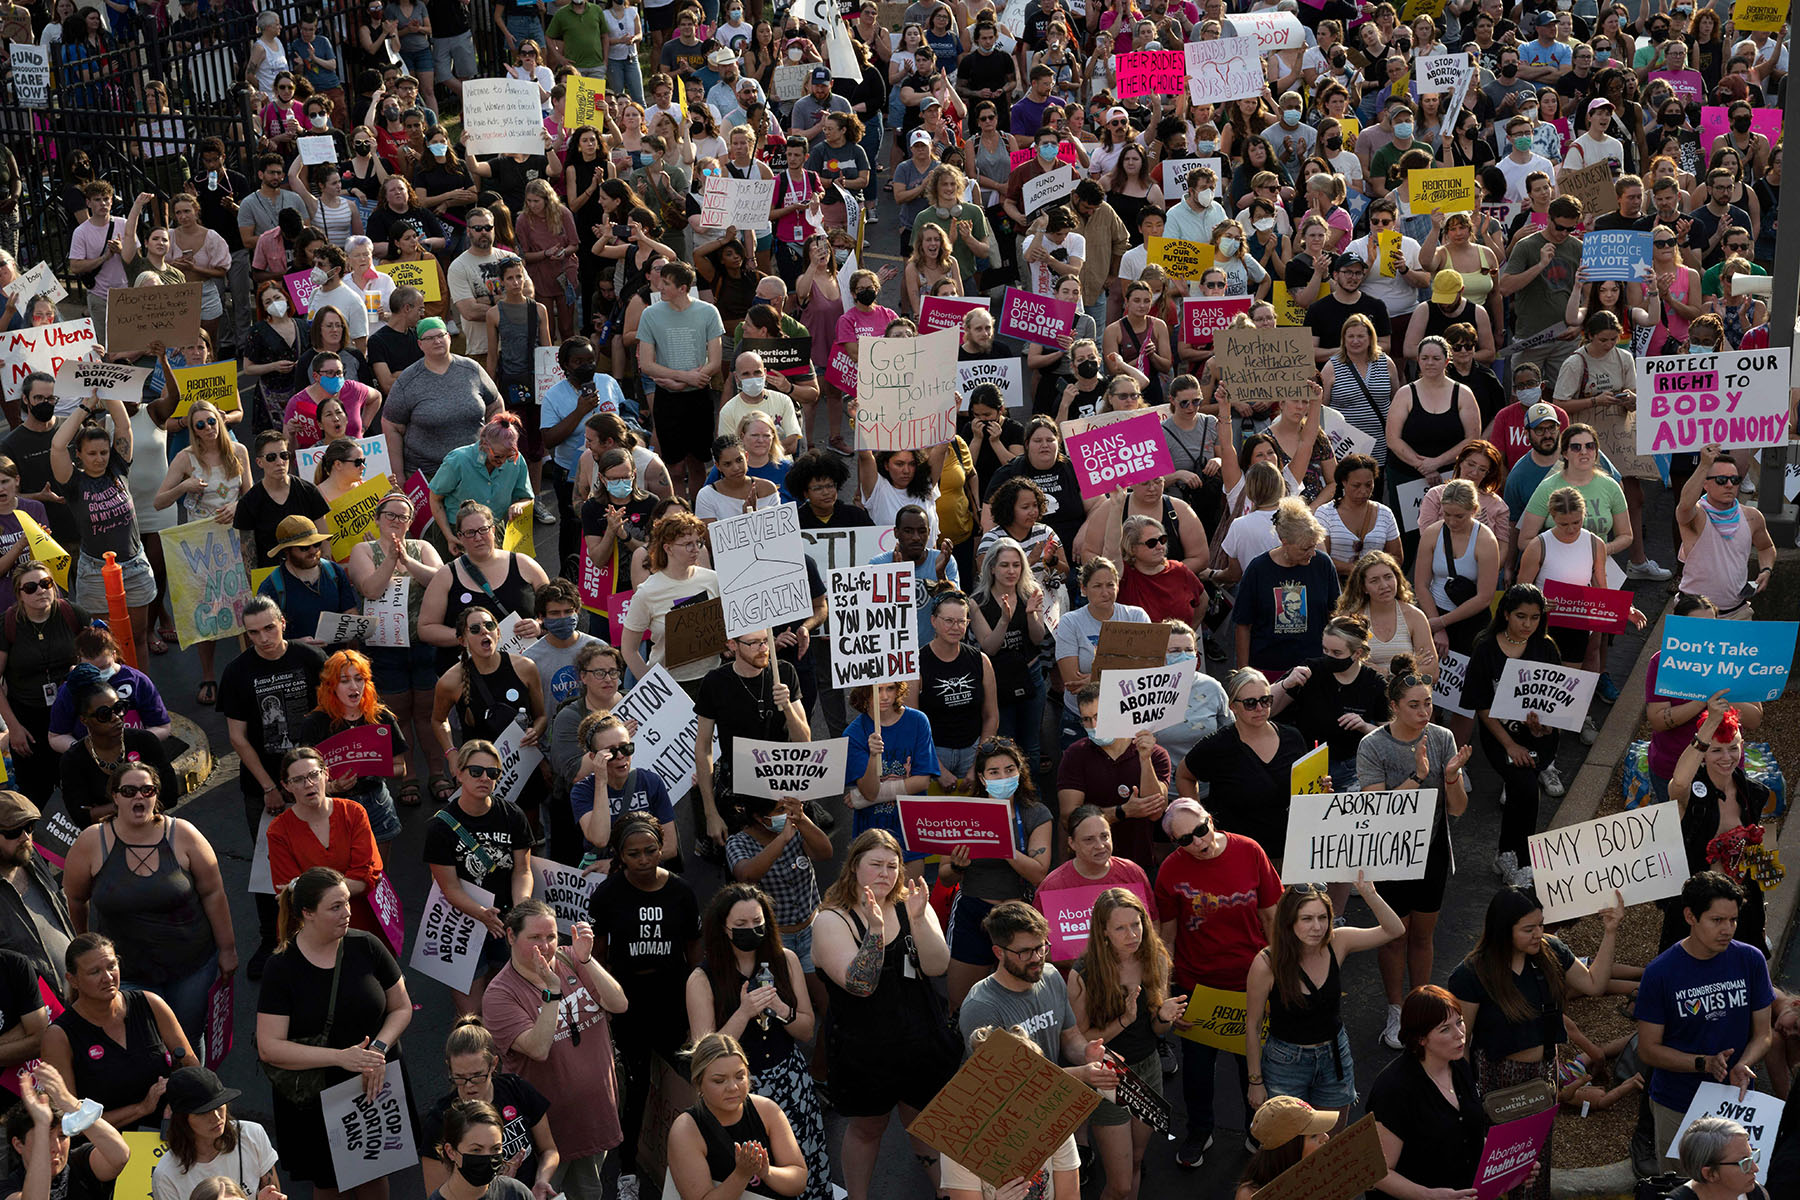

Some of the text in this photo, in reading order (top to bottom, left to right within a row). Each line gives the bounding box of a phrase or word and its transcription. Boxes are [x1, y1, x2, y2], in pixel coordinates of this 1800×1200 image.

[12, 52, 43, 65] FUND
[1190, 40, 1225, 65] HANDS
[1117, 52, 1184, 72] THEIR BODIES
[1434, 58, 1453, 68] STOP
[14, 73, 43, 86] CARE
[1426, 68, 1461, 80] ABORTION
[1435, 77, 1454, 86] BANS
[17, 86, 48, 98] NOW!
[1117, 74, 1183, 93] THEIR CHOICE
[706, 178, 733, 191] NOT
[1036, 176, 1056, 189] FUND
[1422, 178, 1462, 190] ABORTION
[704, 195, 730, 208] NOT
[1030, 182, 1065, 203] ABORTION
[701, 211, 728, 224] NOT
[1163, 241, 1200, 256] OUR BODIES
[1584, 233, 1632, 247] MY BODY
[1600, 245, 1642, 256] CHOICE
[1163, 255, 1199, 265] FUTURES
[1600, 256, 1630, 266] VOTE
[26, 272, 42, 283] body
[930, 309, 962, 320] Abortion
[1012, 298, 1046, 315] BANS
[1192, 308, 1224, 318] BANS
[928, 317, 957, 327] Health
[1009, 318, 1058, 339] BODIES
[1010, 308, 1065, 331] OFF OUR
[1192, 317, 1216, 328] OFF
[791, 348, 798, 356] is
[868, 336, 926, 372] Get
[1226, 336, 1280, 355] Abortion
[91, 364, 120, 372] STOP
[780, 356, 802, 364] Care.
[1646, 356, 1778, 374] PROTECT OUR
[74, 370, 132, 383] ABORTION
[972, 364, 997, 377] STOP
[84, 378, 116, 389] BANS
[186, 376, 226, 391] ABORTION
[1659, 373, 1750, 391] RIGHT TO
[858, 371, 958, 412] your politics
[1237, 384, 1310, 400] HUMAN RIGHT
[1650, 391, 1743, 420] BODY
[857, 406, 917, 424] out of
[858, 405, 957, 451] MY UTERUS
[1652, 409, 1790, 451] AUTONOMY
[1080, 434, 1127, 458] BANS
[1083, 439, 1159, 472] OFF OUR
[1088, 454, 1156, 486] BODIES
[89, 509, 112, 523] IN MY
[334, 495, 380, 526] ABORTION
[714, 506, 797, 554] NEVER
[180, 532, 228, 574] We
[206, 562, 250, 602] NOT
[872, 571, 912, 604] LIE
[728, 579, 810, 633] AGAIN
[1554, 597, 1592, 608] Abortion
[836, 602, 912, 637] YOU DON'T
[1590, 608, 1618, 618] Care.
[840, 631, 909, 656] CARE IF
[1666, 637, 1759, 658] Don't Take
[834, 651, 916, 686] WOMEN DIE
[1532, 669, 1566, 685] STOP
[1662, 656, 1788, 680] Away My Care.
[1137, 674, 1170, 690] STOP
[944, 692, 972, 702] RISE UP
[1120, 690, 1180, 715] ABORTION
[1514, 684, 1575, 708] ABORTION
[1522, 698, 1556, 714] BANS
[1132, 706, 1166, 725] BANS
[352, 742, 363, 750] is
[643, 728, 661, 746] is
[345, 749, 382, 760] Care.
[771, 749, 811, 761] STOP
[754, 764, 828, 779] ABORTION
[768, 779, 810, 791] BANS
[1322, 791, 1420, 821] ABORTION
[915, 818, 980, 828] Abortion is
[917, 828, 1000, 839] Health Care.
[1594, 810, 1660, 858] BODY
[1310, 829, 1426, 869] HEALTHCARE
[556, 872, 586, 890] STOP
[1546, 852, 1673, 908] MY CHOICE!!
[426, 902, 444, 940] STOP
[555, 905, 587, 923] BANS
[638, 907, 664, 922] GOD
[454, 917, 476, 956] BANS
[640, 924, 662, 939] IS A
[628, 940, 672, 957] WOMAN
[1675, 978, 1746, 1001] MY CONGRESSWOMAN
[1728, 988, 1748, 1008] ME
[1202, 1018, 1216, 1030] is
[952, 1049, 1004, 1097] LIKE
[940, 1044, 1040, 1155] ABORTIONS?
[1494, 1095, 1545, 1114] CAMERA BAG
[1510, 1094, 1526, 1103] THE
[381, 1098, 402, 1135] STOP
[961, 1063, 1062, 1170] IGNORE THEM
[1004, 1080, 1073, 1152] YOU IGNORE
[1716, 1101, 1757, 1122] BANS
[341, 1110, 362, 1152] BANS
[352, 1093, 382, 1160] ABORTION
[1000, 1091, 1097, 1184] SCHOOL SHOOTINGS
[1488, 1136, 1534, 1162] Abortion is
[1482, 1156, 1516, 1178] Health
